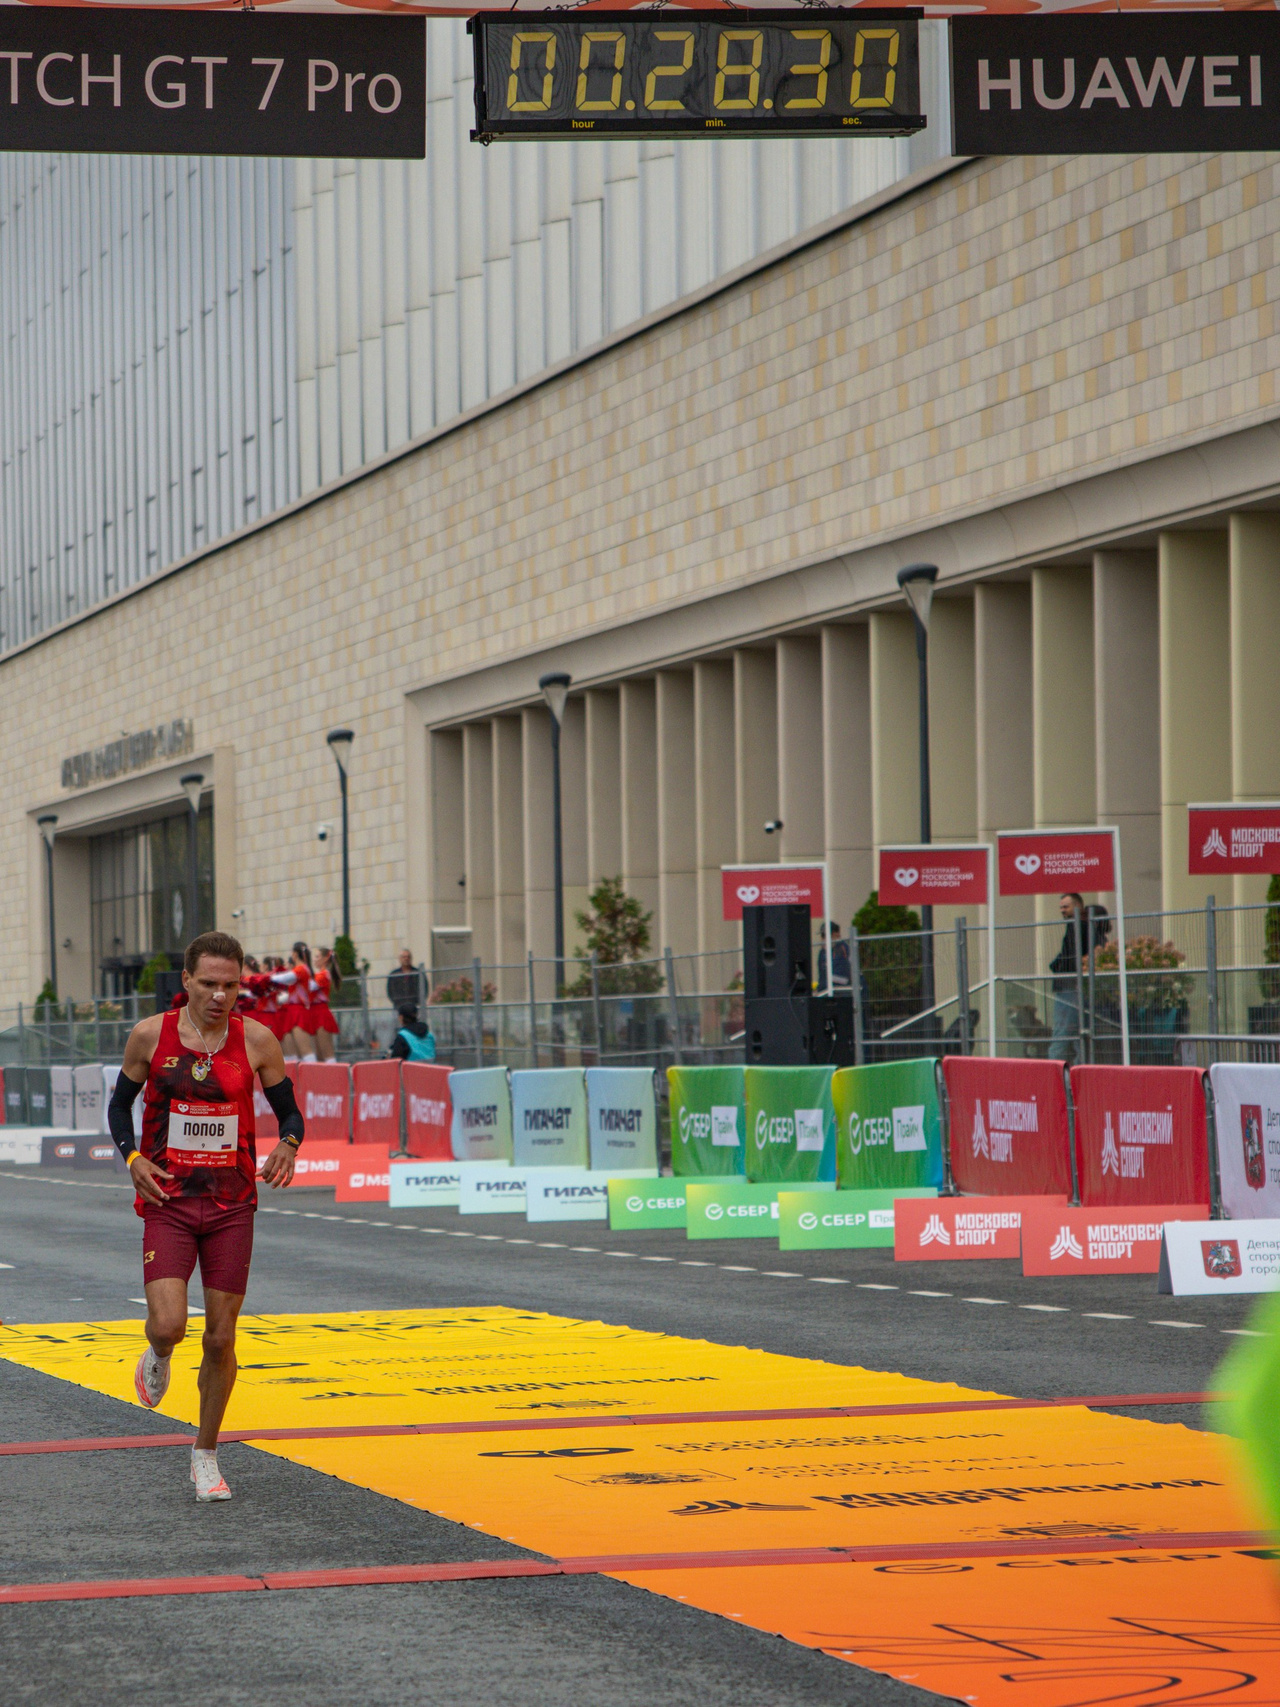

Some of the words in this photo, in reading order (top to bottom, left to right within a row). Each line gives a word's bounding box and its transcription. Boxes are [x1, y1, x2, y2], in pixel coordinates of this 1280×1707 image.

[144, 55, 227, 109] GT
[250, 59, 285, 110] 7
[309, 60, 403, 114] Pro
[979, 55, 1263, 111] HUAWEI
[572, 119, 595, 128] hour
[705, 118, 726, 128] min.
[842, 116, 862, 126] sec.
[1231, 843, 1265, 858] СПОРТ
[1044, 857, 1100, 867] МОСКОВСКИЙ
[1044, 866, 1085, 875] МАРАФОН
[989, 1095, 1038, 1132] МОСКОВСКИЙ
[183, 1122, 225, 1136] ПОПОВ
[689, 1113, 710, 1137] СБЕР
[770, 1117, 793, 1143] СБЕР
[1119, 1104, 1173, 1144] МОСКОВСКИЙ
[863, 1118, 891, 1147] СБЕР
[990, 1132, 1012, 1163] СПОРТ
[1121, 1147, 1145, 1178] СПОРТ
[476, 1181, 526, 1192] ГИГА
[647, 1198, 685, 1209] СБЕР
[727, 1205, 768, 1217] СБЕР
[822, 1214, 865, 1226] СБЕР
[956, 1229, 997, 1246] СПОРТ
[1089, 1242, 1133, 1259] СПОРТ
[810, 1479, 1225, 1502] МОСКОВСКИЙ
[996, 1553, 1222, 1569] СБЕР
